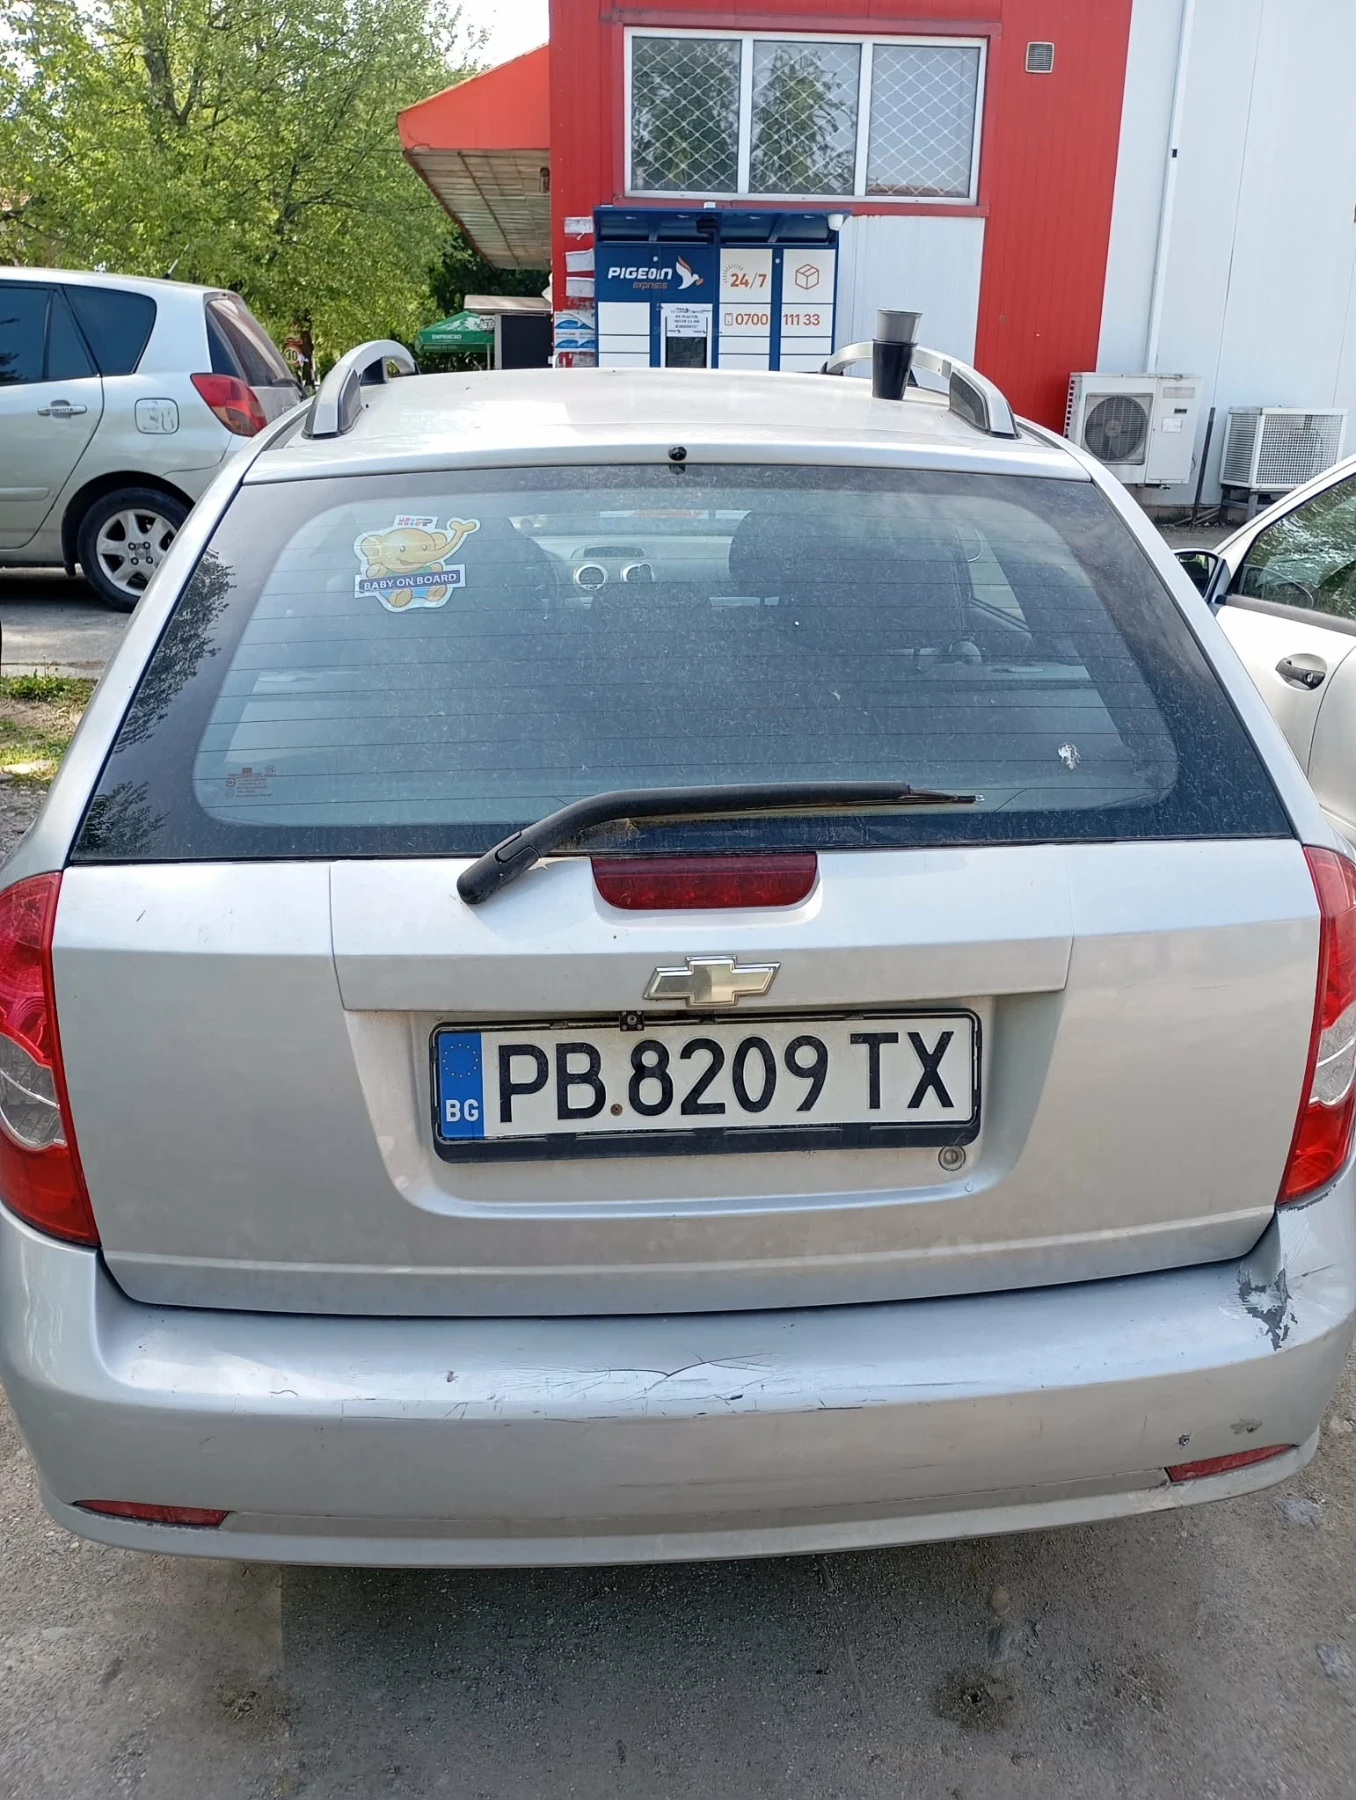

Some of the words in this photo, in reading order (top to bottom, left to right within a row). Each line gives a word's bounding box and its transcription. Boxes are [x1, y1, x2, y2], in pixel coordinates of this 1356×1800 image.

[730, 271, 767, 290] 24/7
[735, 313, 769, 326] 0700
[783, 313, 800, 326] 111
[803, 313, 820, 326] 33
[363, 579, 394, 591] BABY
[396, 578, 415, 587] ON
[416, 573, 457, 585] BOARD
[498, 1042, 607, 1123] PB
[628, 1035, 829, 1117] 8209
[849, 1031, 955, 1110] TX
[445, 1098, 479, 1122] BG
